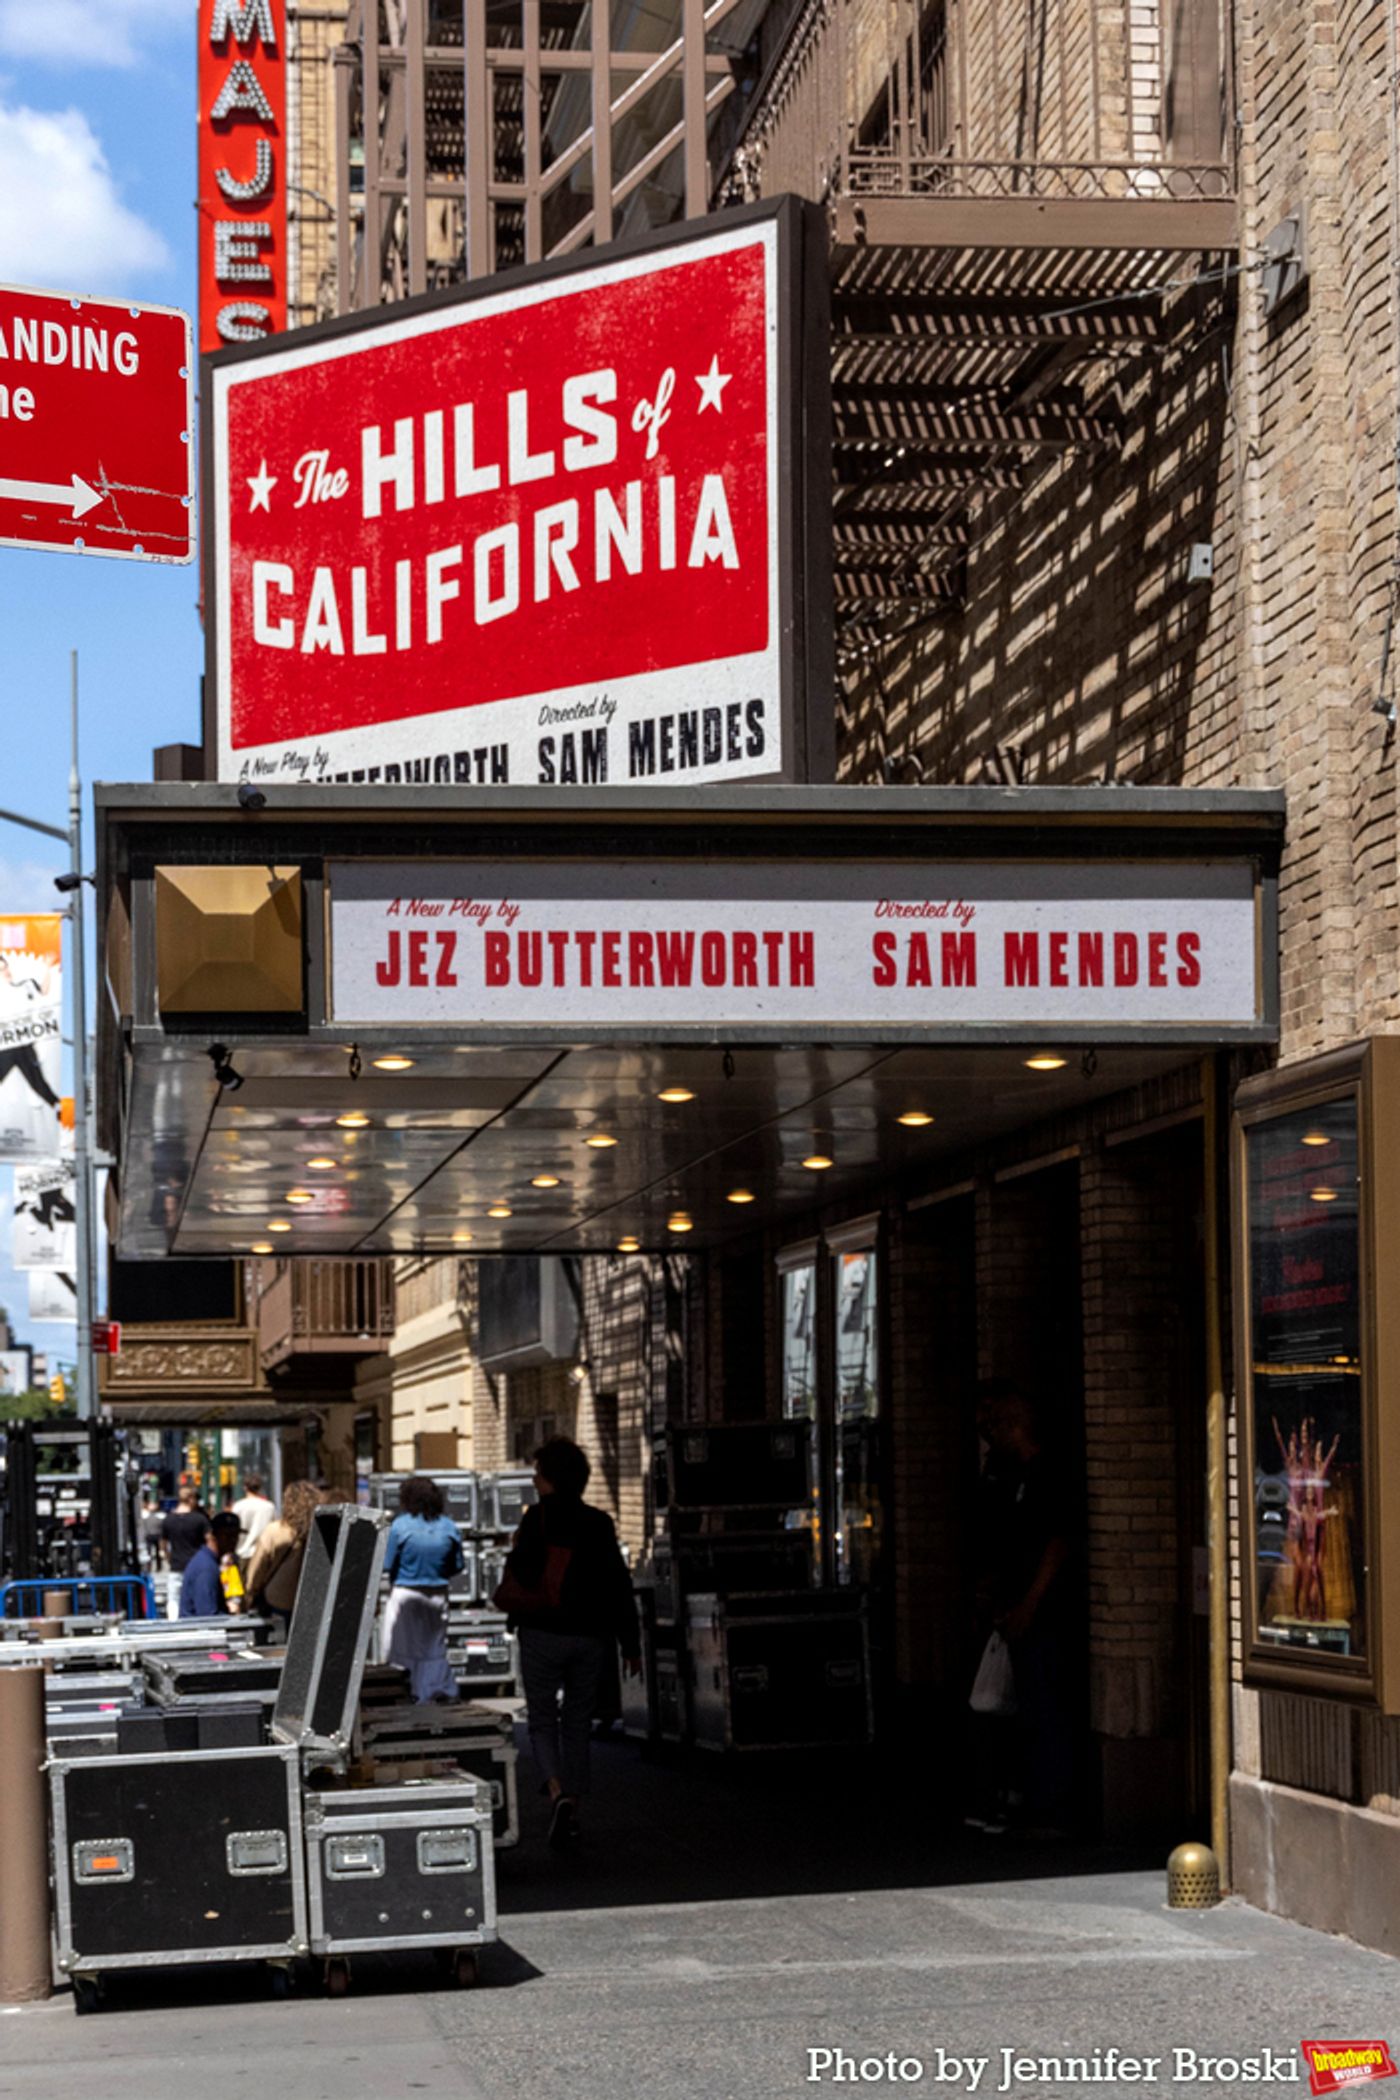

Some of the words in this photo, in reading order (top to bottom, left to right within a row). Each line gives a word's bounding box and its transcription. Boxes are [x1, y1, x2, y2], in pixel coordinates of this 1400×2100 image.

[293, 450, 349, 508] The
[361, 368, 617, 519] HILLS
[631, 368, 676, 459] of
[252, 474, 740, 656] CALIFORNIA
[538, 698, 598, 726] Directed
[598, 694, 617, 724] by
[240, 758, 250, 776] A
[252, 757, 278, 776] New
[280, 751, 310, 778] Play
[313, 746, 329, 774] by
[538, 727, 608, 783] SAM
[628, 699, 766, 778] MENDES
[387, 896, 402, 916] A
[405, 897, 445, 916] New
[448, 897, 492, 926] Play
[497, 896, 520, 926] by
[874, 898, 951, 918] Directed
[952, 898, 976, 927] by
[376, 931, 458, 987] JEZ
[485, 931, 815, 987] BUTTERWORTH
[872, 931, 977, 987] SAM
[1004, 931, 1200, 987] MENDES
[0, 1018, 60, 1045] RMON
